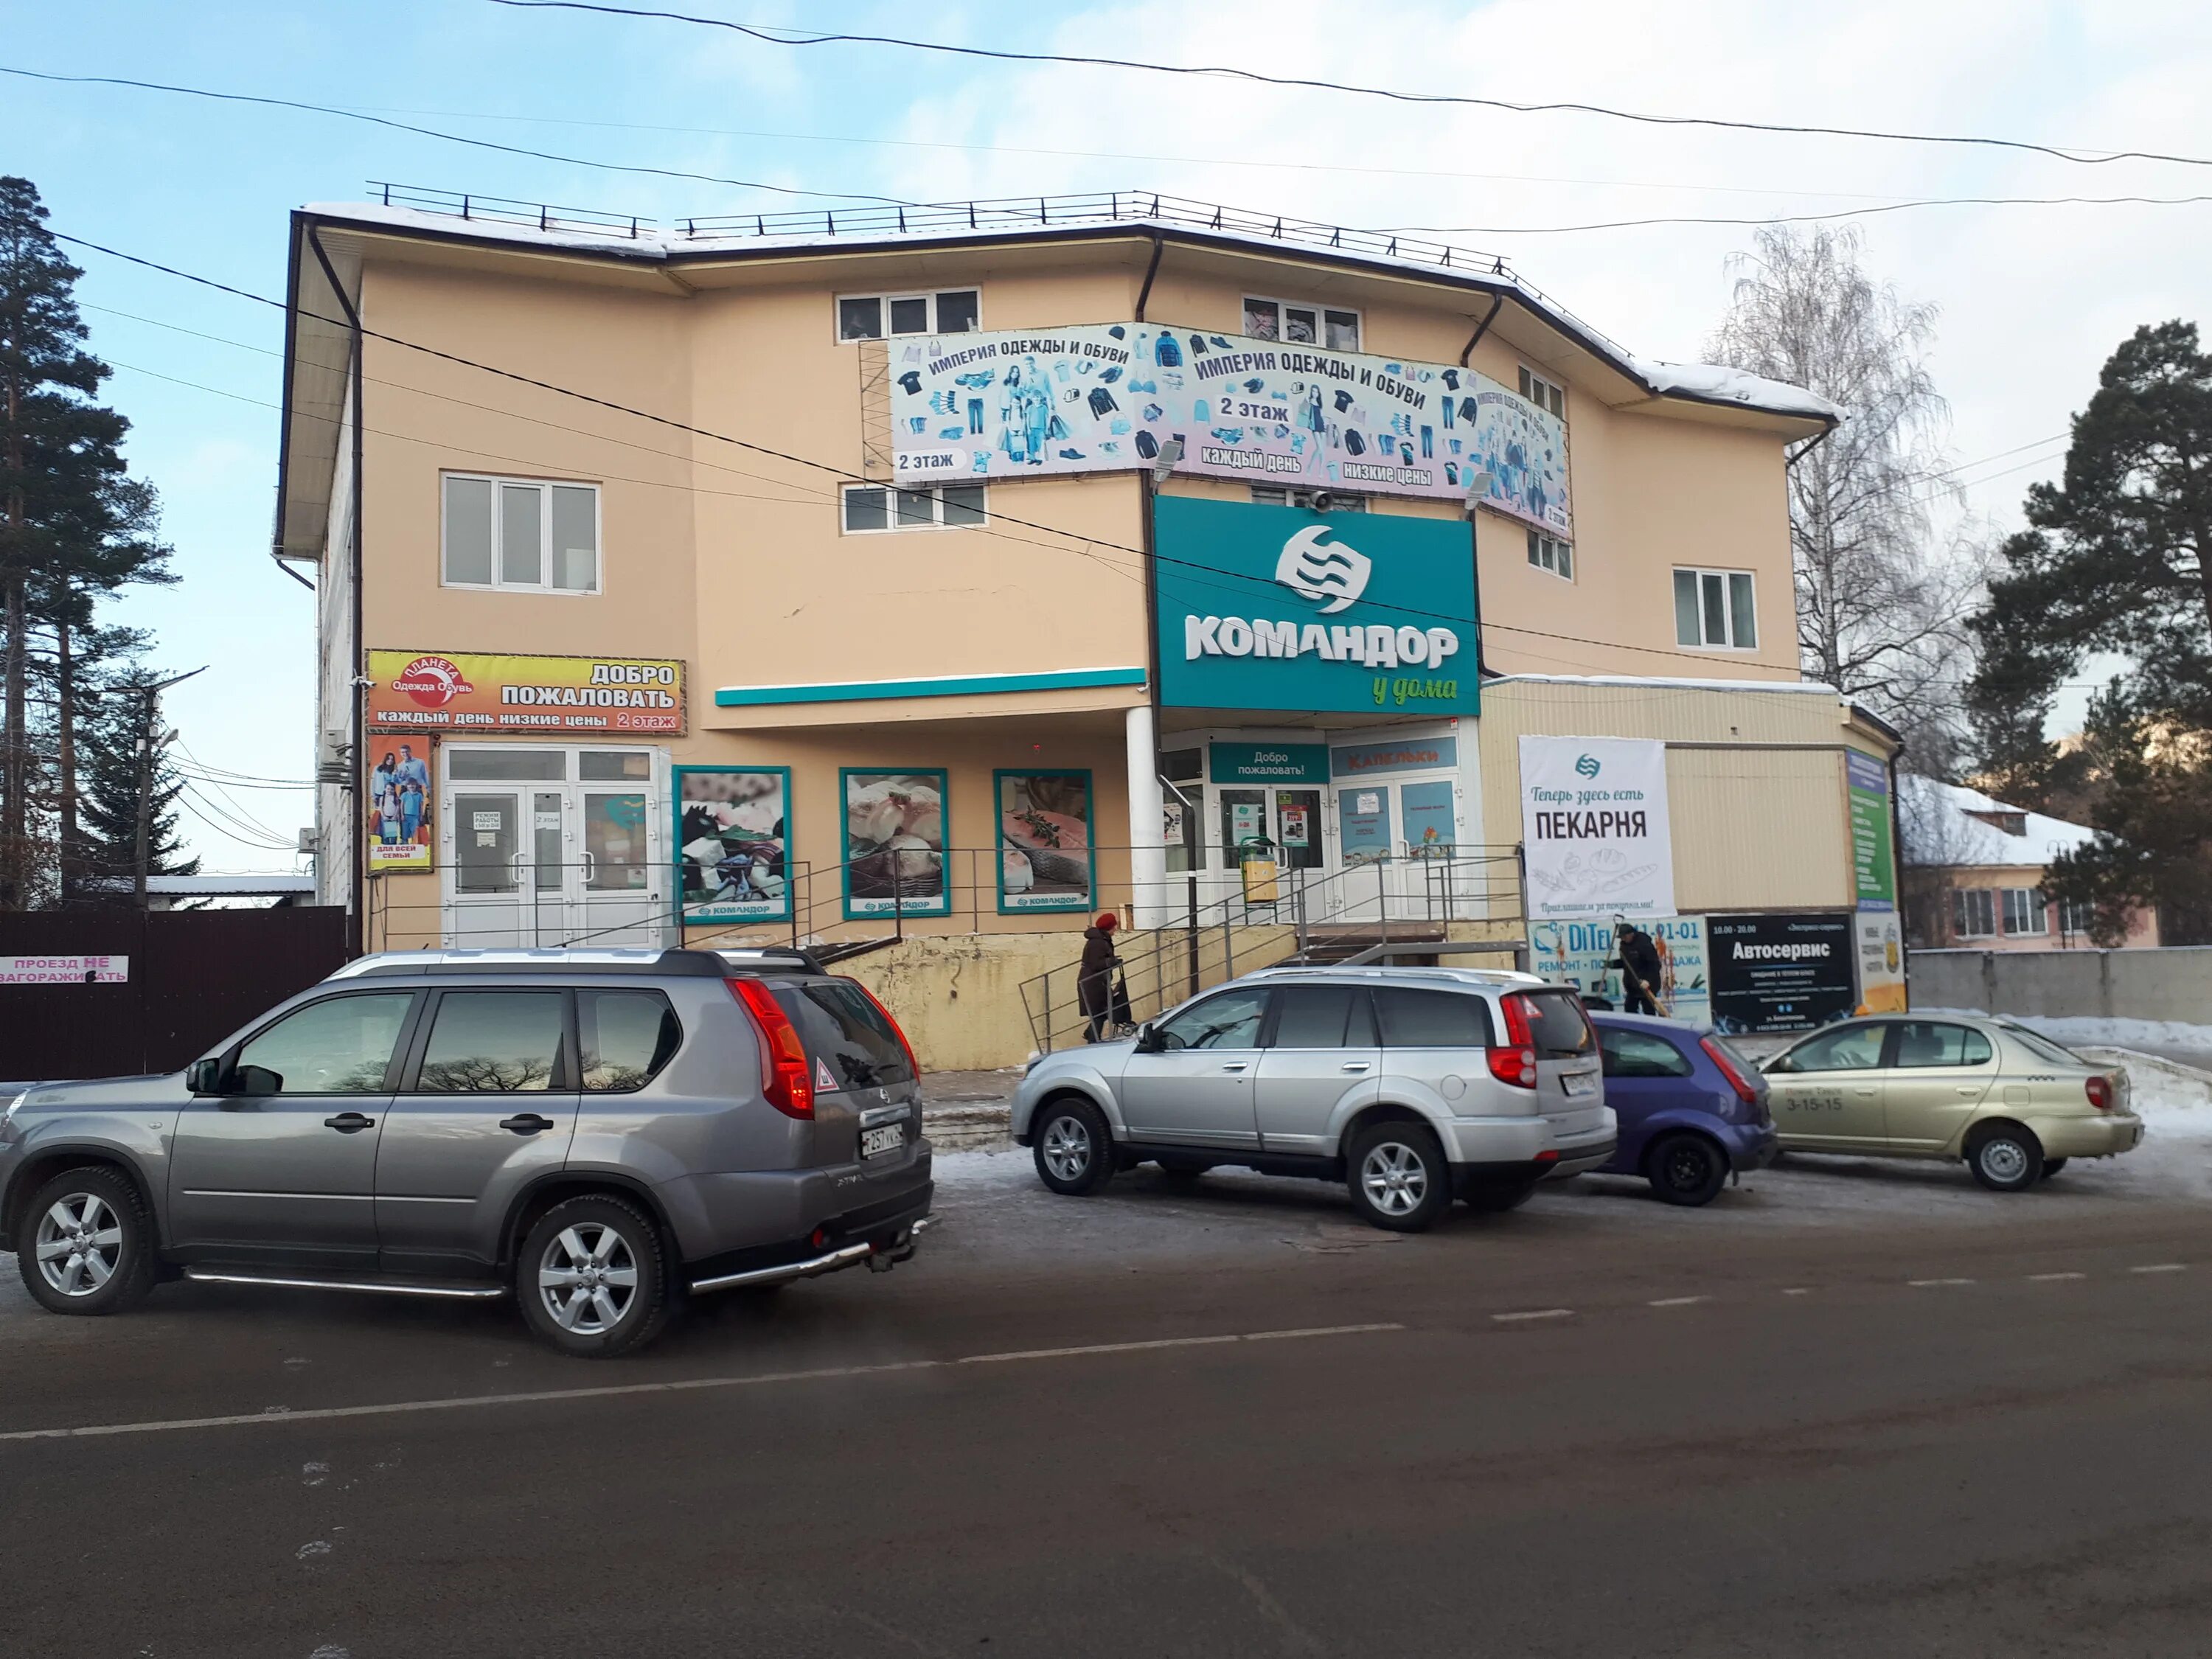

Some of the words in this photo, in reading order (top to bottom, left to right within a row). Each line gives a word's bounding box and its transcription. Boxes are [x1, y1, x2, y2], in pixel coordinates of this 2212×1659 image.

[928, 344, 998, 377] ИМПЕРИЯ
[1000, 339, 1065, 356] ОДЕЖДЫ
[1069, 341, 1081, 355] И
[1083, 343, 1130, 365] ОБУВИ
[1194, 352, 1276, 380] ИМПЕРИЯ
[1281, 351, 1355, 380] ОДЕЖДЫ
[1360, 369, 1372, 387] И
[1375, 375, 1427, 410] ОБУВИ
[1220, 397, 1234, 415] 2
[1238, 401, 1289, 422] этаж
[898, 454, 908, 470] 2
[913, 453, 953, 470] этаж
[1201, 445, 1264, 469] каждый
[1265, 453, 1302, 474] день
[1343, 462, 1394, 483] низкие
[1397, 468, 1432, 487] цены
[1185, 614, 1459, 669] КОМАНДОР
[404, 658, 459, 679] ПЛАНЕТА
[591, 664, 675, 685] ДОБРО
[392, 681, 435, 692] Одежда
[437, 682, 472, 693] Обувь
[501, 685, 675, 709] ПОЖАЛОВАТЬ
[1373, 678, 1388, 705] у
[1392, 678, 1458, 705] дома
[377, 709, 450, 724] каждый
[453, 713, 495, 726] день
[498, 714, 560, 726] низкие
[564, 716, 608, 728] цены
[616, 713, 630, 728] 2
[632, 715, 676, 728] этаж
[1254, 751, 1289, 765] Добро
[1238, 765, 1304, 776] пожаловать!
[1531, 786, 1572, 805] Теперь
[1576, 790, 1610, 806] здесь
[1613, 790, 1644, 801] есть
[1536, 810, 1647, 840] ПЕКАРНЯ
[713, 906, 770, 915] КОМАНДОР
[1030, 897, 1077, 905] КОМАНДОР
[1733, 942, 1831, 961] Автосервис
[15, 959, 78, 969] ПРОЕЗД
[83, 957, 110, 967] НЕ
[1538, 960, 1580, 972] РЕМОНТ
